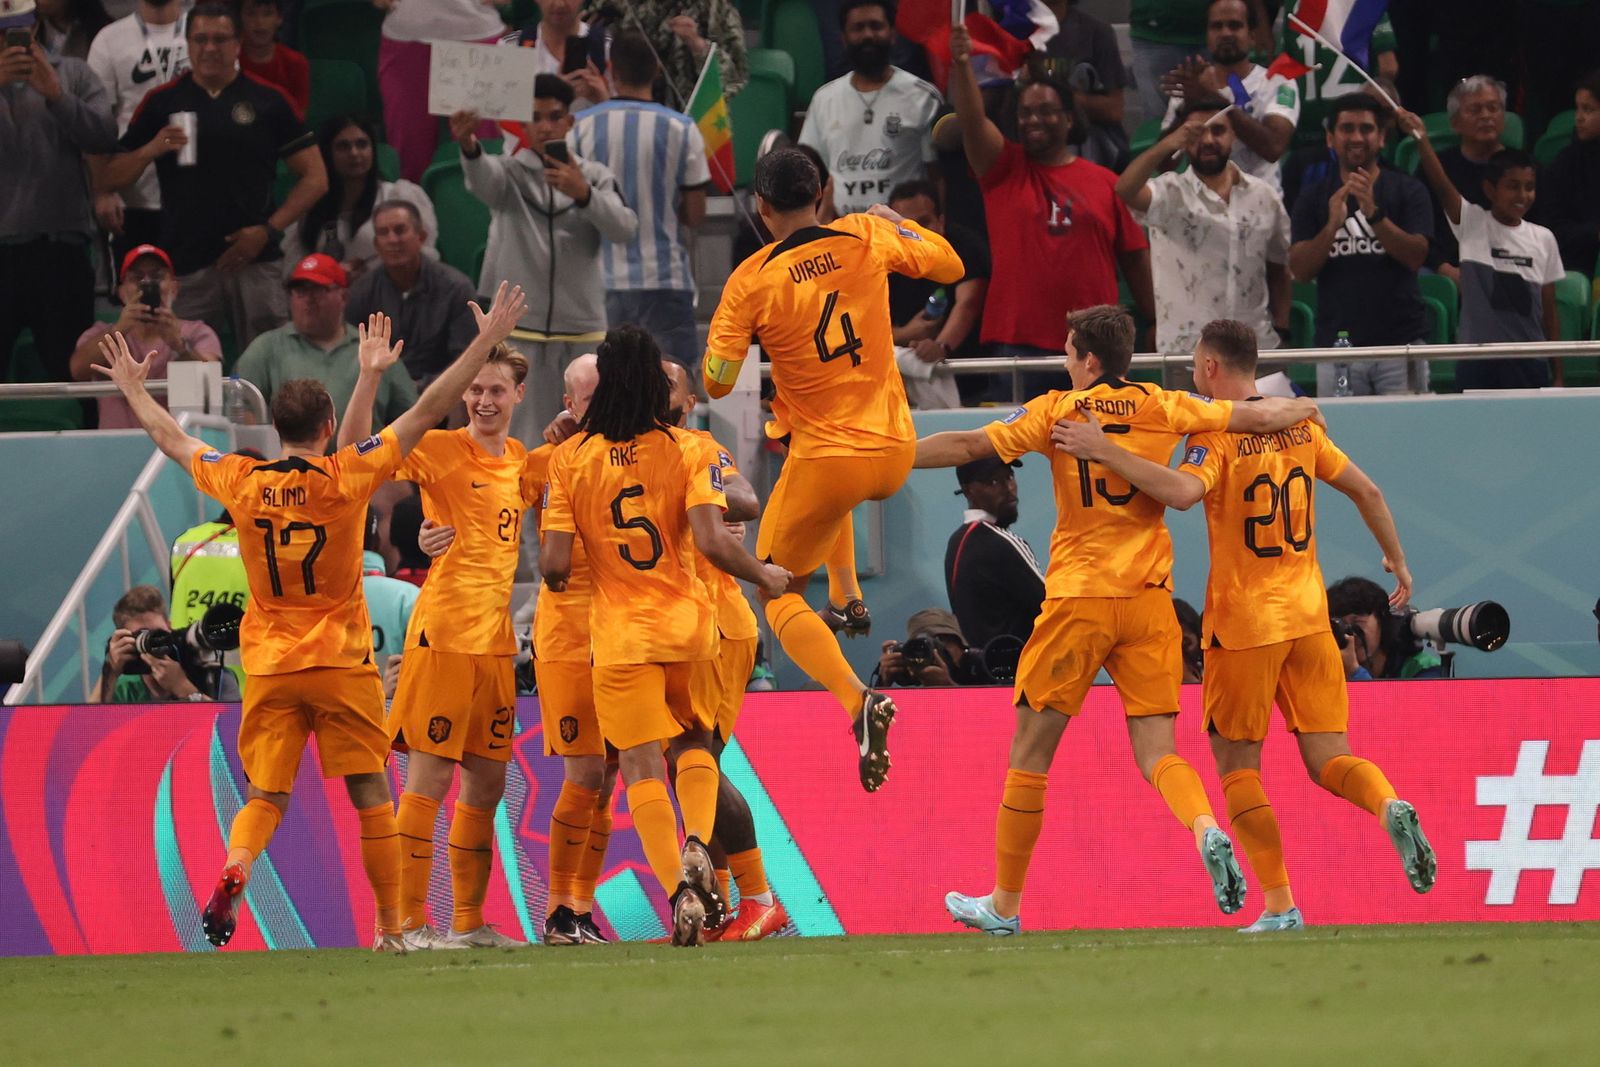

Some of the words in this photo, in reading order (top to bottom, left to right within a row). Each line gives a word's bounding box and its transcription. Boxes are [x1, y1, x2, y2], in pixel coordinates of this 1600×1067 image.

[844, 178, 892, 196] YPF
[1329, 236, 1387, 258] adida
[788, 251, 842, 284] VIRGIL
[814, 289, 863, 368] 4
[1094, 400, 1136, 416] ROON
[609, 441, 638, 466] AKÉ
[263, 487, 306, 507] BLIND
[1243, 466, 1312, 558] 20
[498, 508, 519, 542] 21
[610, 484, 663, 570] 5
[254, 518, 327, 597] 17
[186, 590, 245, 608] 2446
[490, 706, 515, 739] 21
